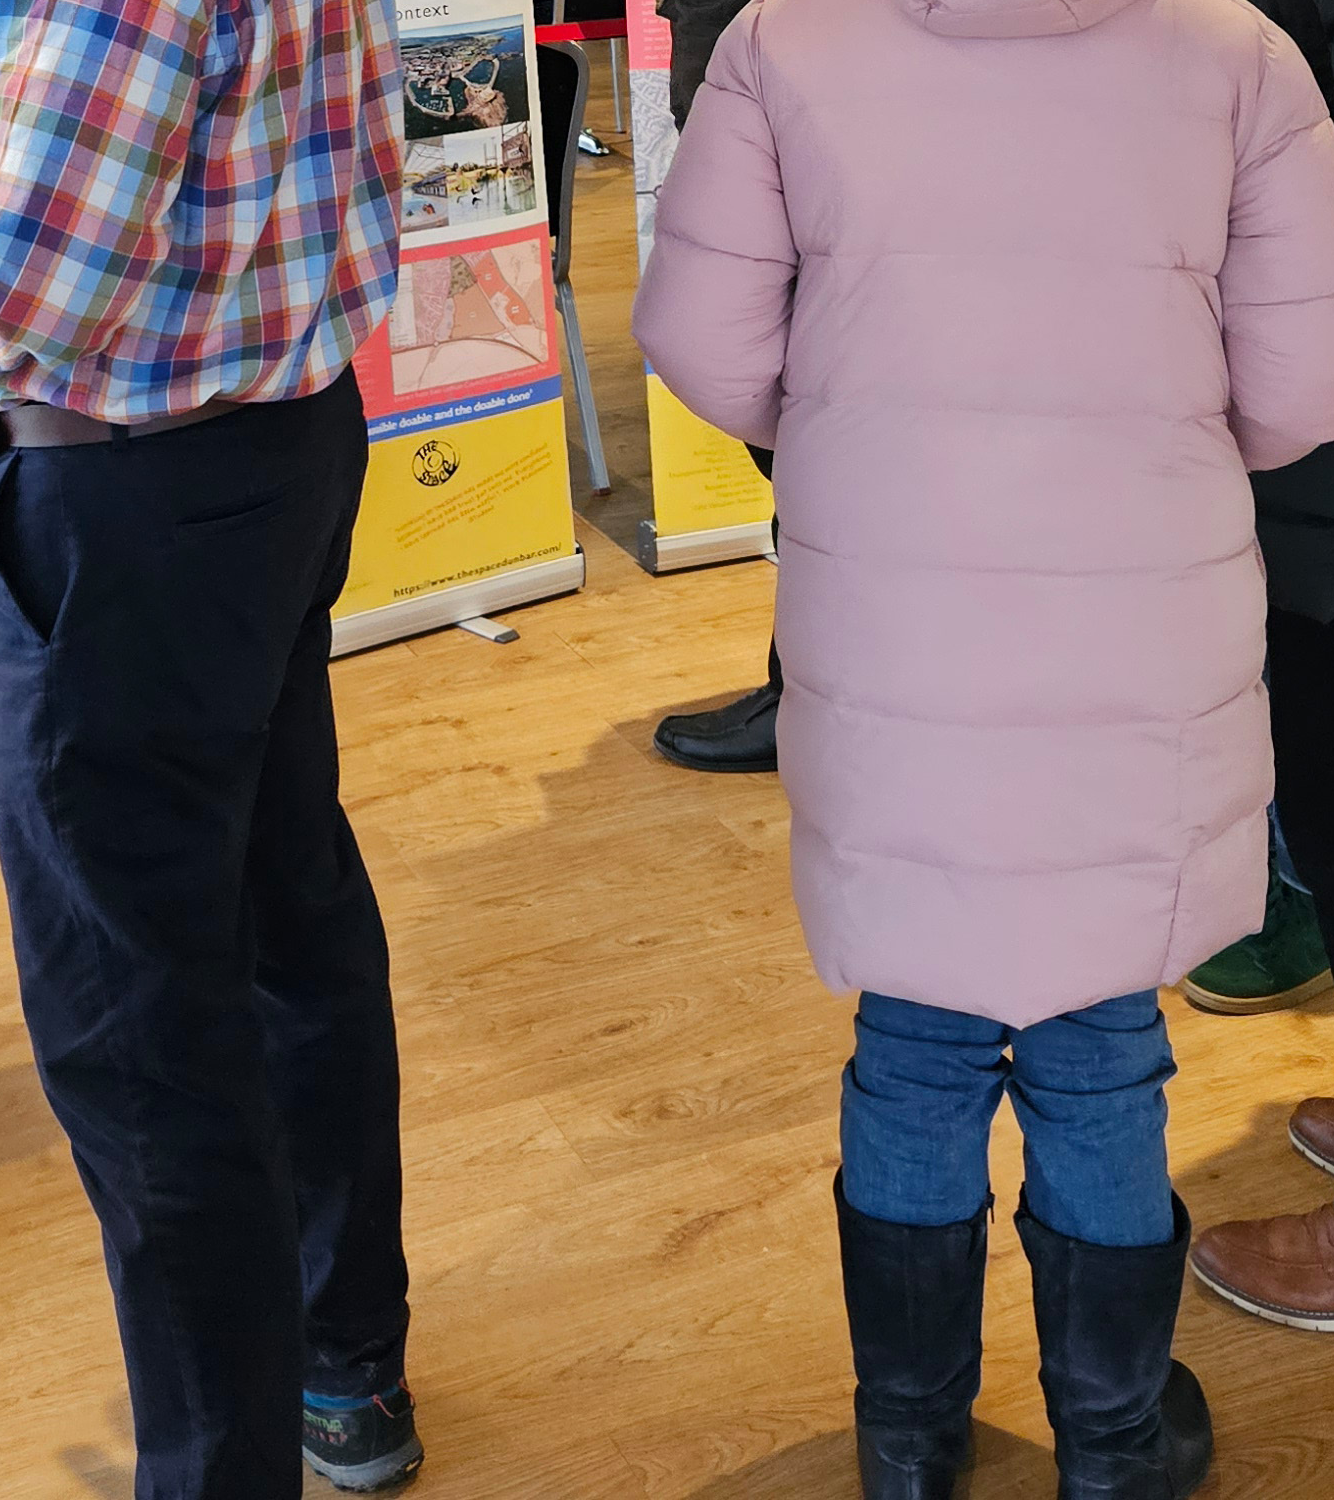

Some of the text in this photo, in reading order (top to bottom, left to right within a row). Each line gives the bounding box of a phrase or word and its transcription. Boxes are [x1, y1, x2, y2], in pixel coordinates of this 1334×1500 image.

[399, 409, 433, 429] doable
[434, 406, 453, 420] and
[455, 404, 473, 417] the
[474, 396, 506, 418] doable
